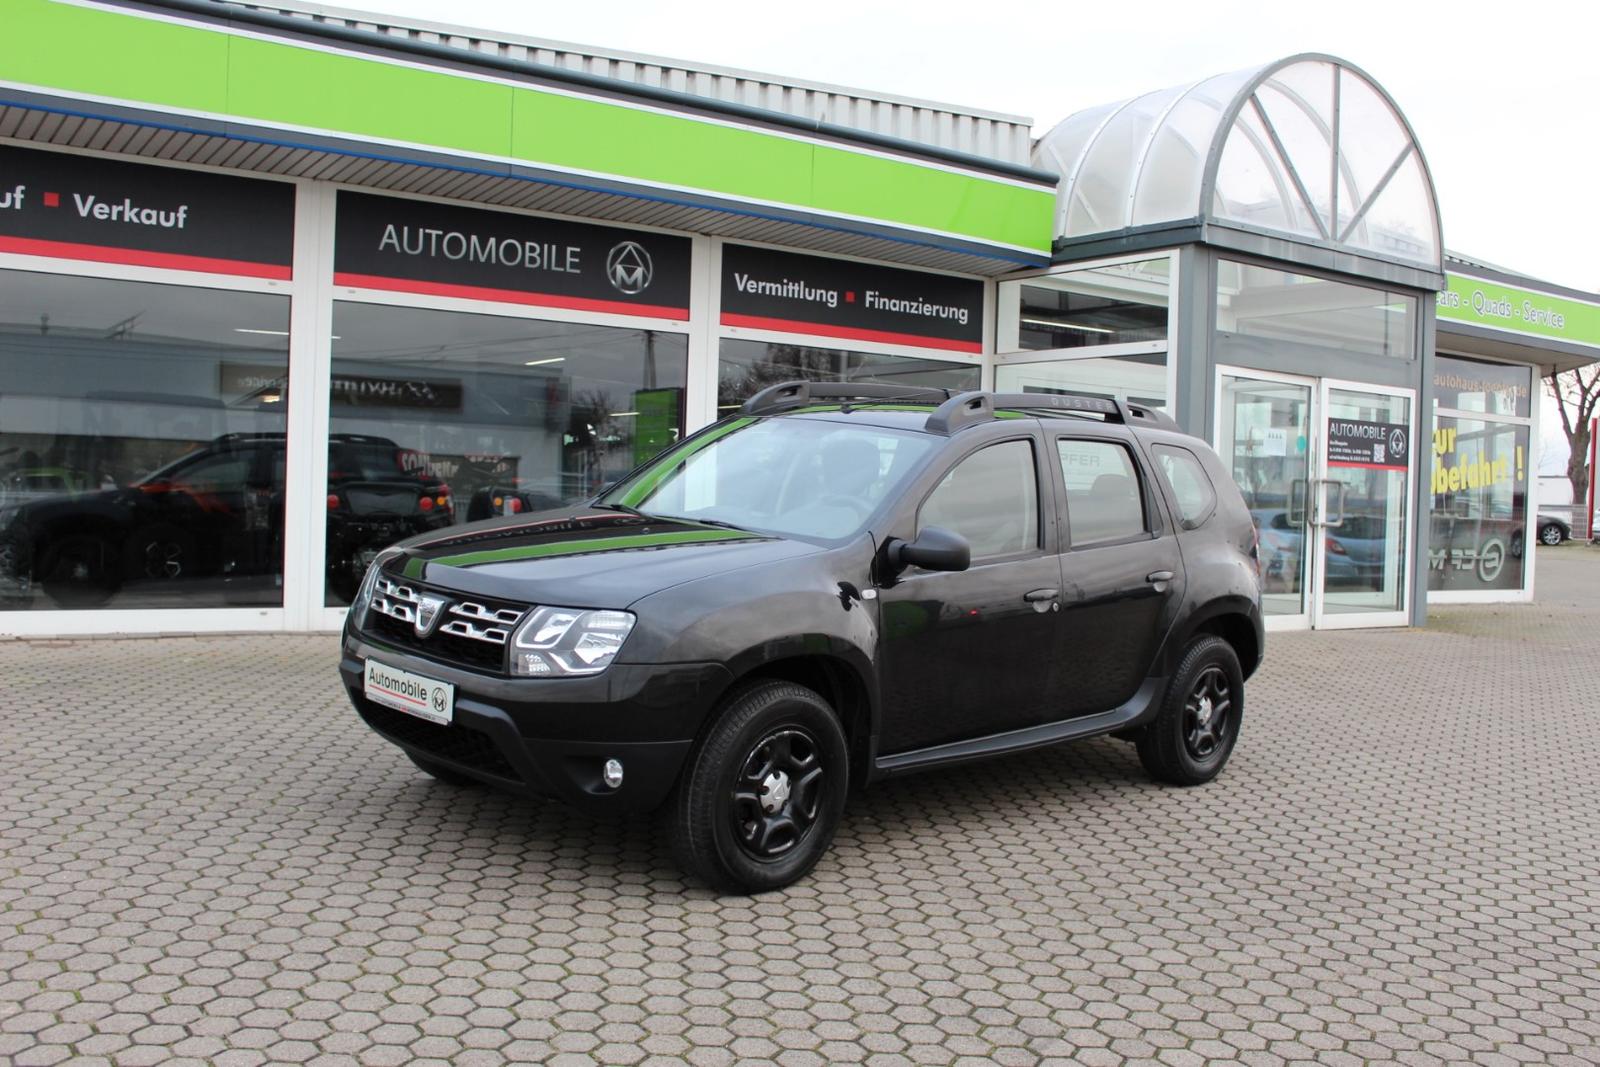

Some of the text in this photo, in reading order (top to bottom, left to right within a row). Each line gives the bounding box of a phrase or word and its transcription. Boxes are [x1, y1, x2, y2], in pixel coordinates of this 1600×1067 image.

[73, 193, 188, 229] Verkauf
[379, 223, 582, 274] AUTOMOBILE
[734, 272, 969, 325] Vermittlung Finanzierung
[1436, 290, 1459, 308] ars
[1471, 289, 1512, 318] Quads
[1523, 299, 1565, 329] Service
[1051, 397, 1114, 412] DUSTER
[1329, 421, 1386, 440] AUTOMOBILE
[1433, 427, 1457, 455] ur
[368, 667, 428, 701] Automobile
